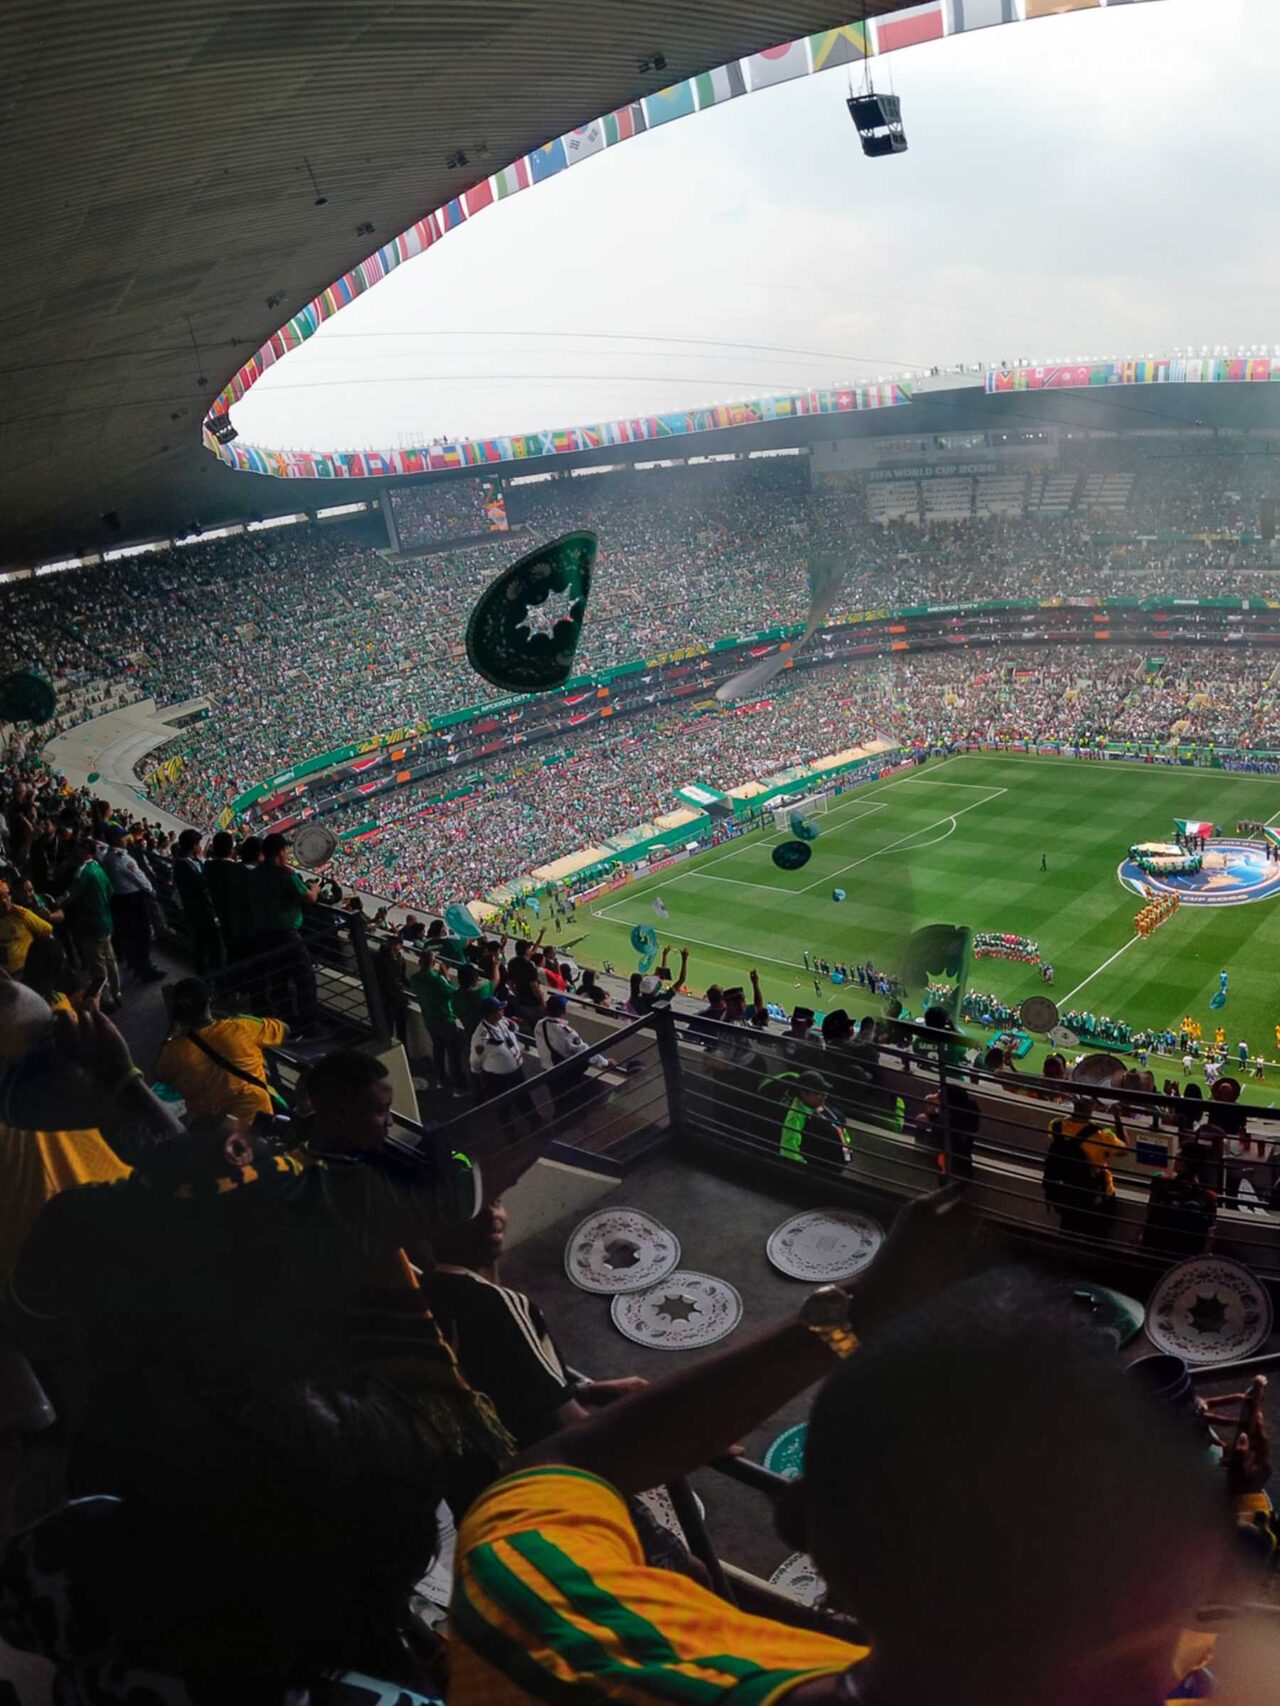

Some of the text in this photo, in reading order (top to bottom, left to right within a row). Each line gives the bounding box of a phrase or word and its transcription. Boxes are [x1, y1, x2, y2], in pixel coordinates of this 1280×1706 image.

[870, 469, 893, 480] FIFA
[894, 467, 933, 478] WORLD
[935, 466, 957, 476] CUP
[927, 604, 959, 612] MEXICO
